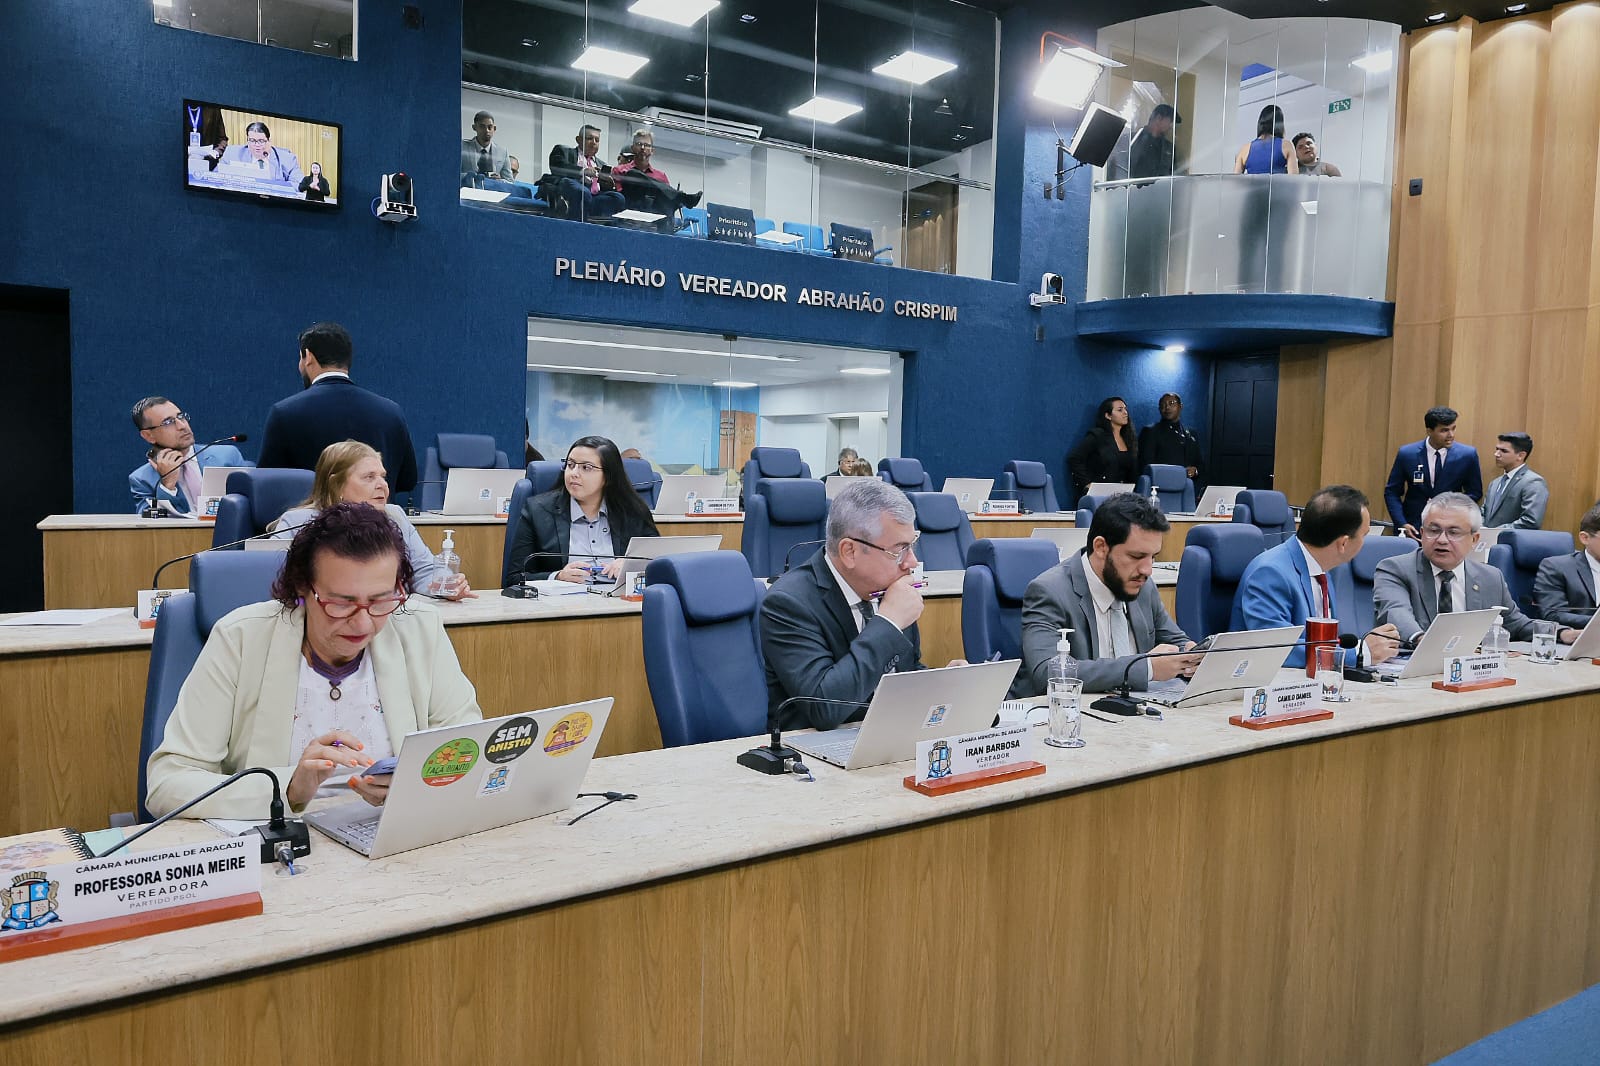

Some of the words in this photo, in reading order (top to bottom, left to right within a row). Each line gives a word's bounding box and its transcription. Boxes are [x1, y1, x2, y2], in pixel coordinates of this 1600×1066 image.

[718, 216, 748, 227] Prioritário
[842, 235, 868, 246] Prioritário
[555, 258, 666, 288] PLENÁRIO
[679, 272, 787, 303] VEREADOR
[798, 288, 885, 314] ABRAHÃO
[894, 300, 958, 322] CRISPIM
[1277, 694, 1296, 702] CAMILO
[494, 723, 533, 744] SEM
[958, 736, 977, 744] CÂMARA
[978, 732, 1001, 741] MUNICIPAL
[487, 737, 533, 754] ANISTIA
[965, 747, 984, 758] IRAN
[985, 739, 1021, 754] BARBOSA
[976, 752, 1010, 764] VEREADOR
[75, 860, 122, 874] CÂMARA
[124, 852, 181, 866] MUNICIPAL
[183, 848, 197, 857] DE
[199, 841, 245, 854] ARACAJU
[74, 870, 162, 897] PROFESSORA
[165, 863, 205, 882] SONIA
[208, 856, 246, 875] MEIRE
[117, 880, 209, 903] VEREADORA
[129, 897, 171, 909] PARTIDO
[173, 892, 198, 902] PSOL
